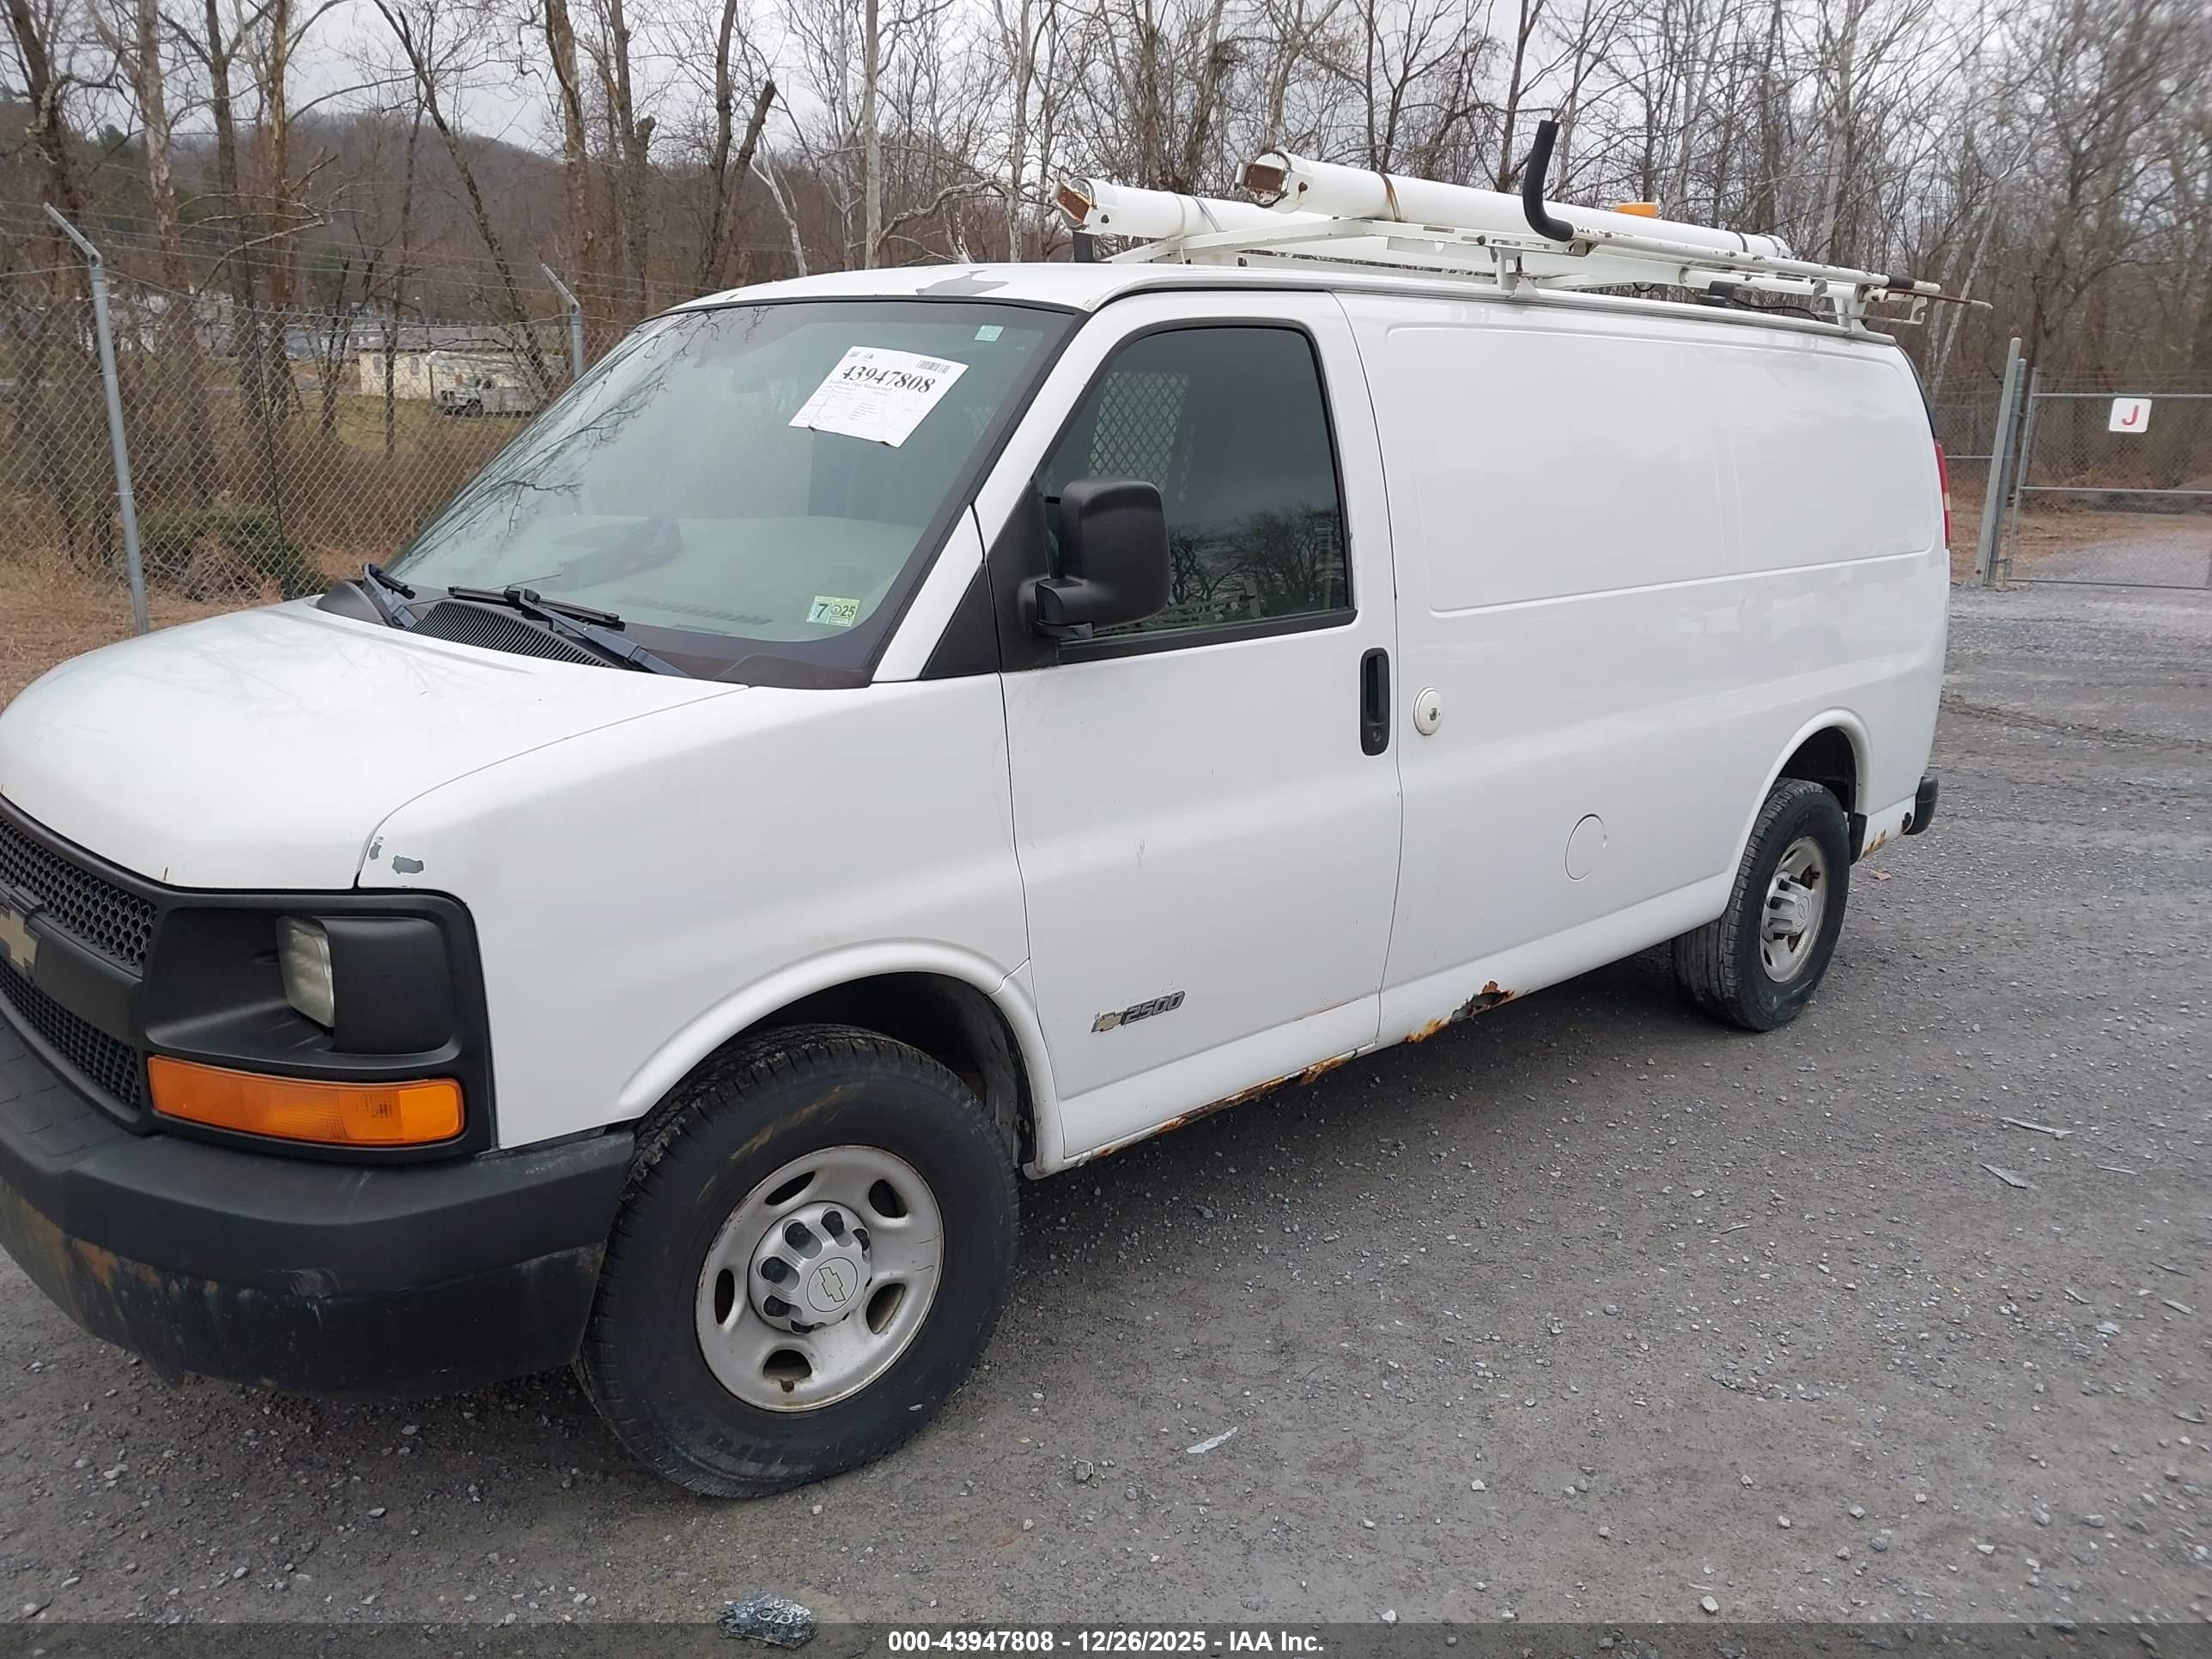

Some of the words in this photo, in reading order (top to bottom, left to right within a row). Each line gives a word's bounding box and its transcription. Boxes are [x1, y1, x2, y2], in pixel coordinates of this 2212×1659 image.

[842, 365, 936, 393] 43947808
[2121, 404, 2140, 426] J
[817, 604, 829, 618] 7
[840, 605, 856, 618] 25
[1121, 991, 1186, 1025] 2500
